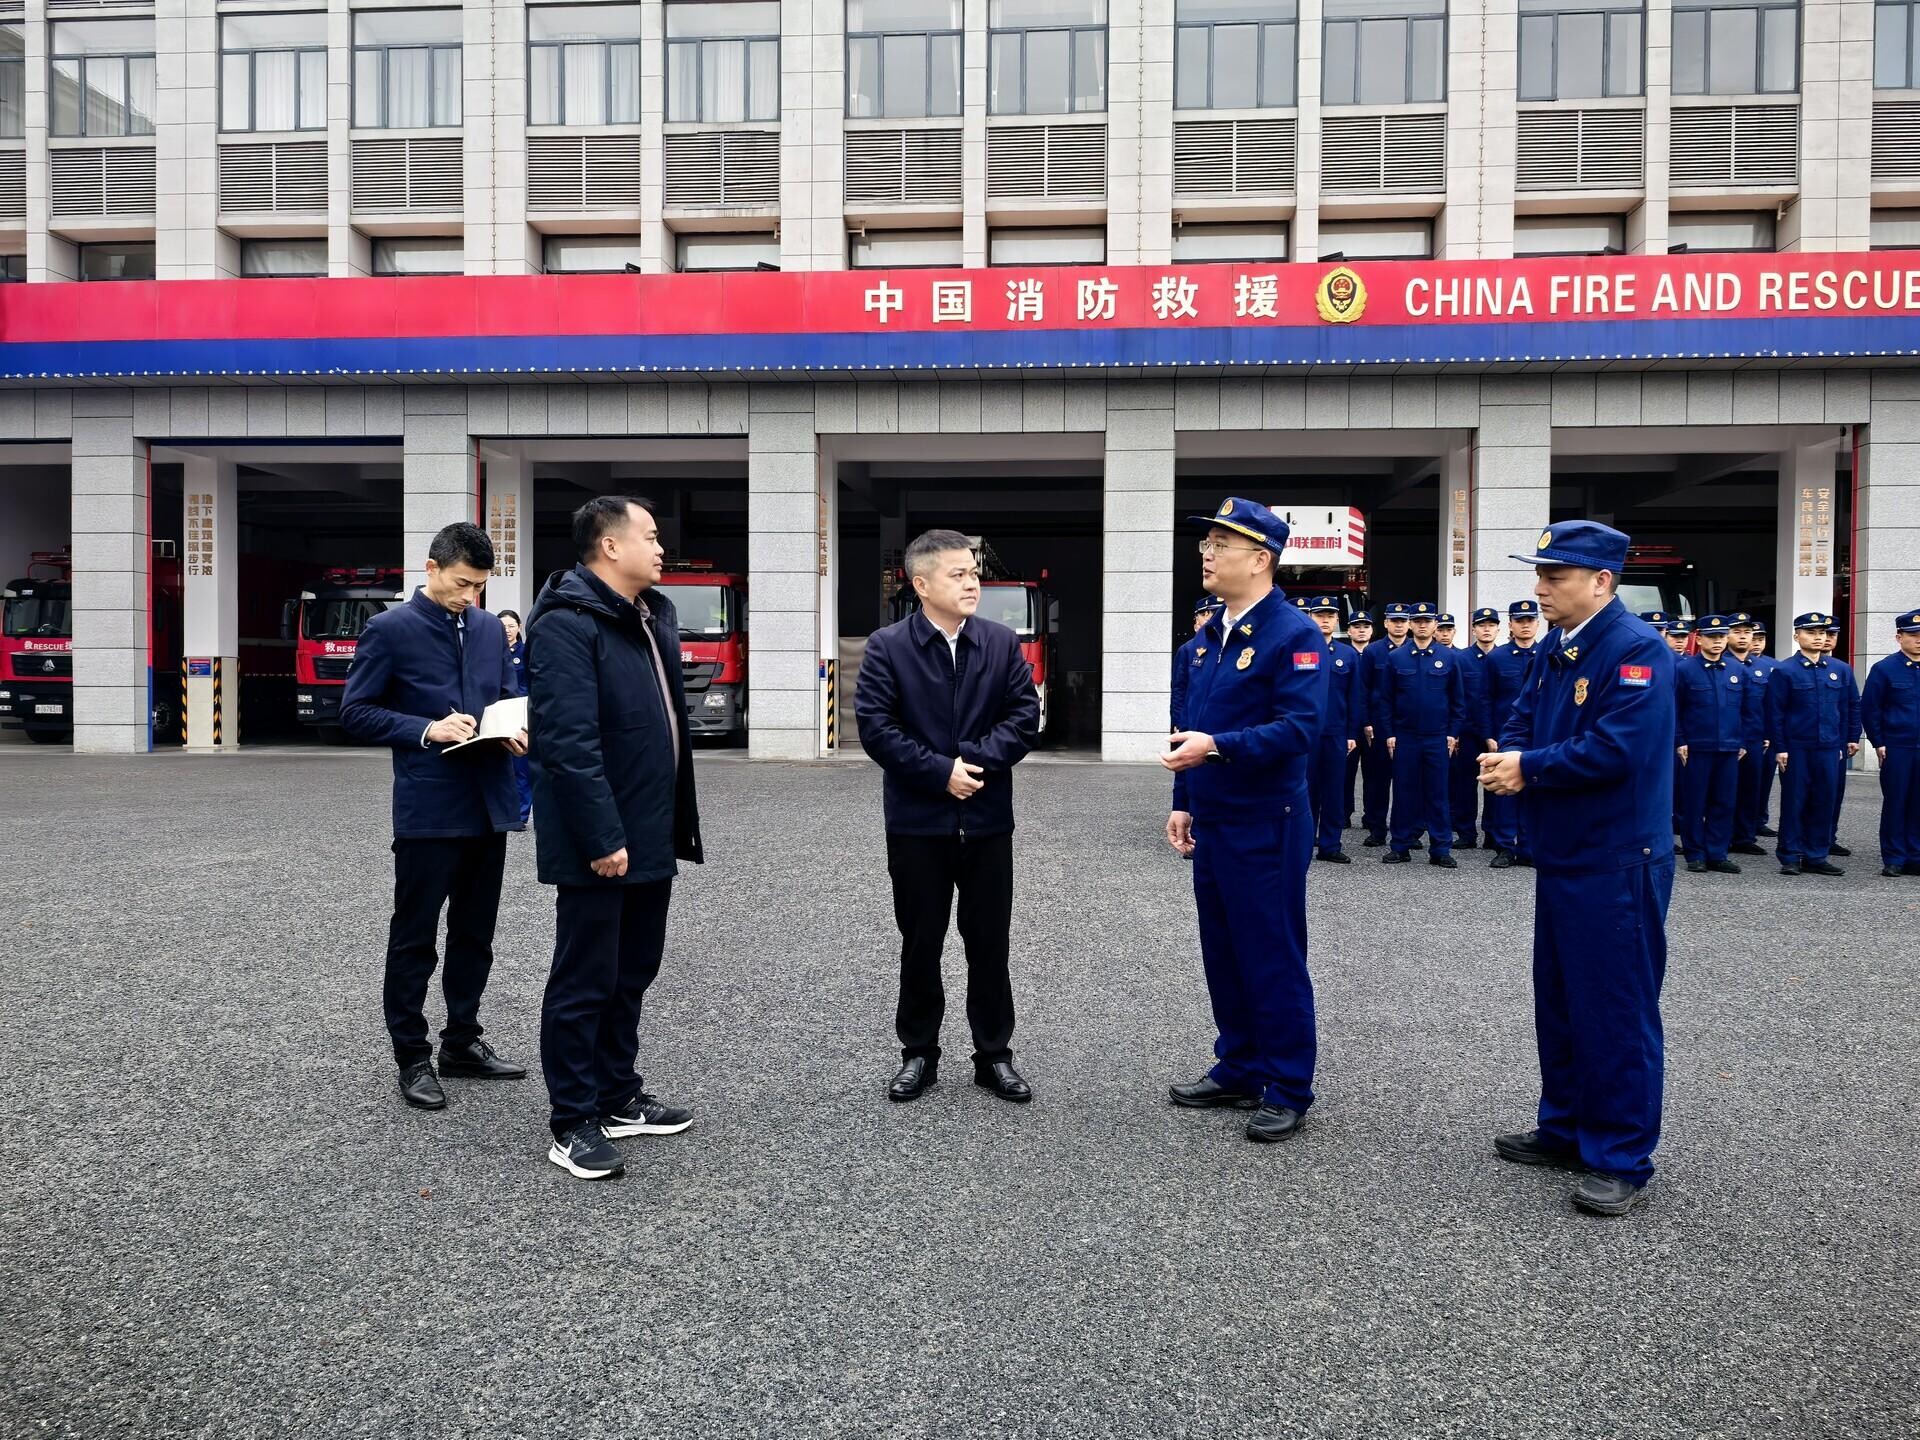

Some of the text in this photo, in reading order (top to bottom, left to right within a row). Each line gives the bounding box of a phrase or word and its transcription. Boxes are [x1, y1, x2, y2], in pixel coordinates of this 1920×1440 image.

[864, 275, 1280, 323] 中国消防救援
[1405, 270, 1920, 317] CHINA FIRE AND RESCUE
[681, 650, 693, 662] 援
